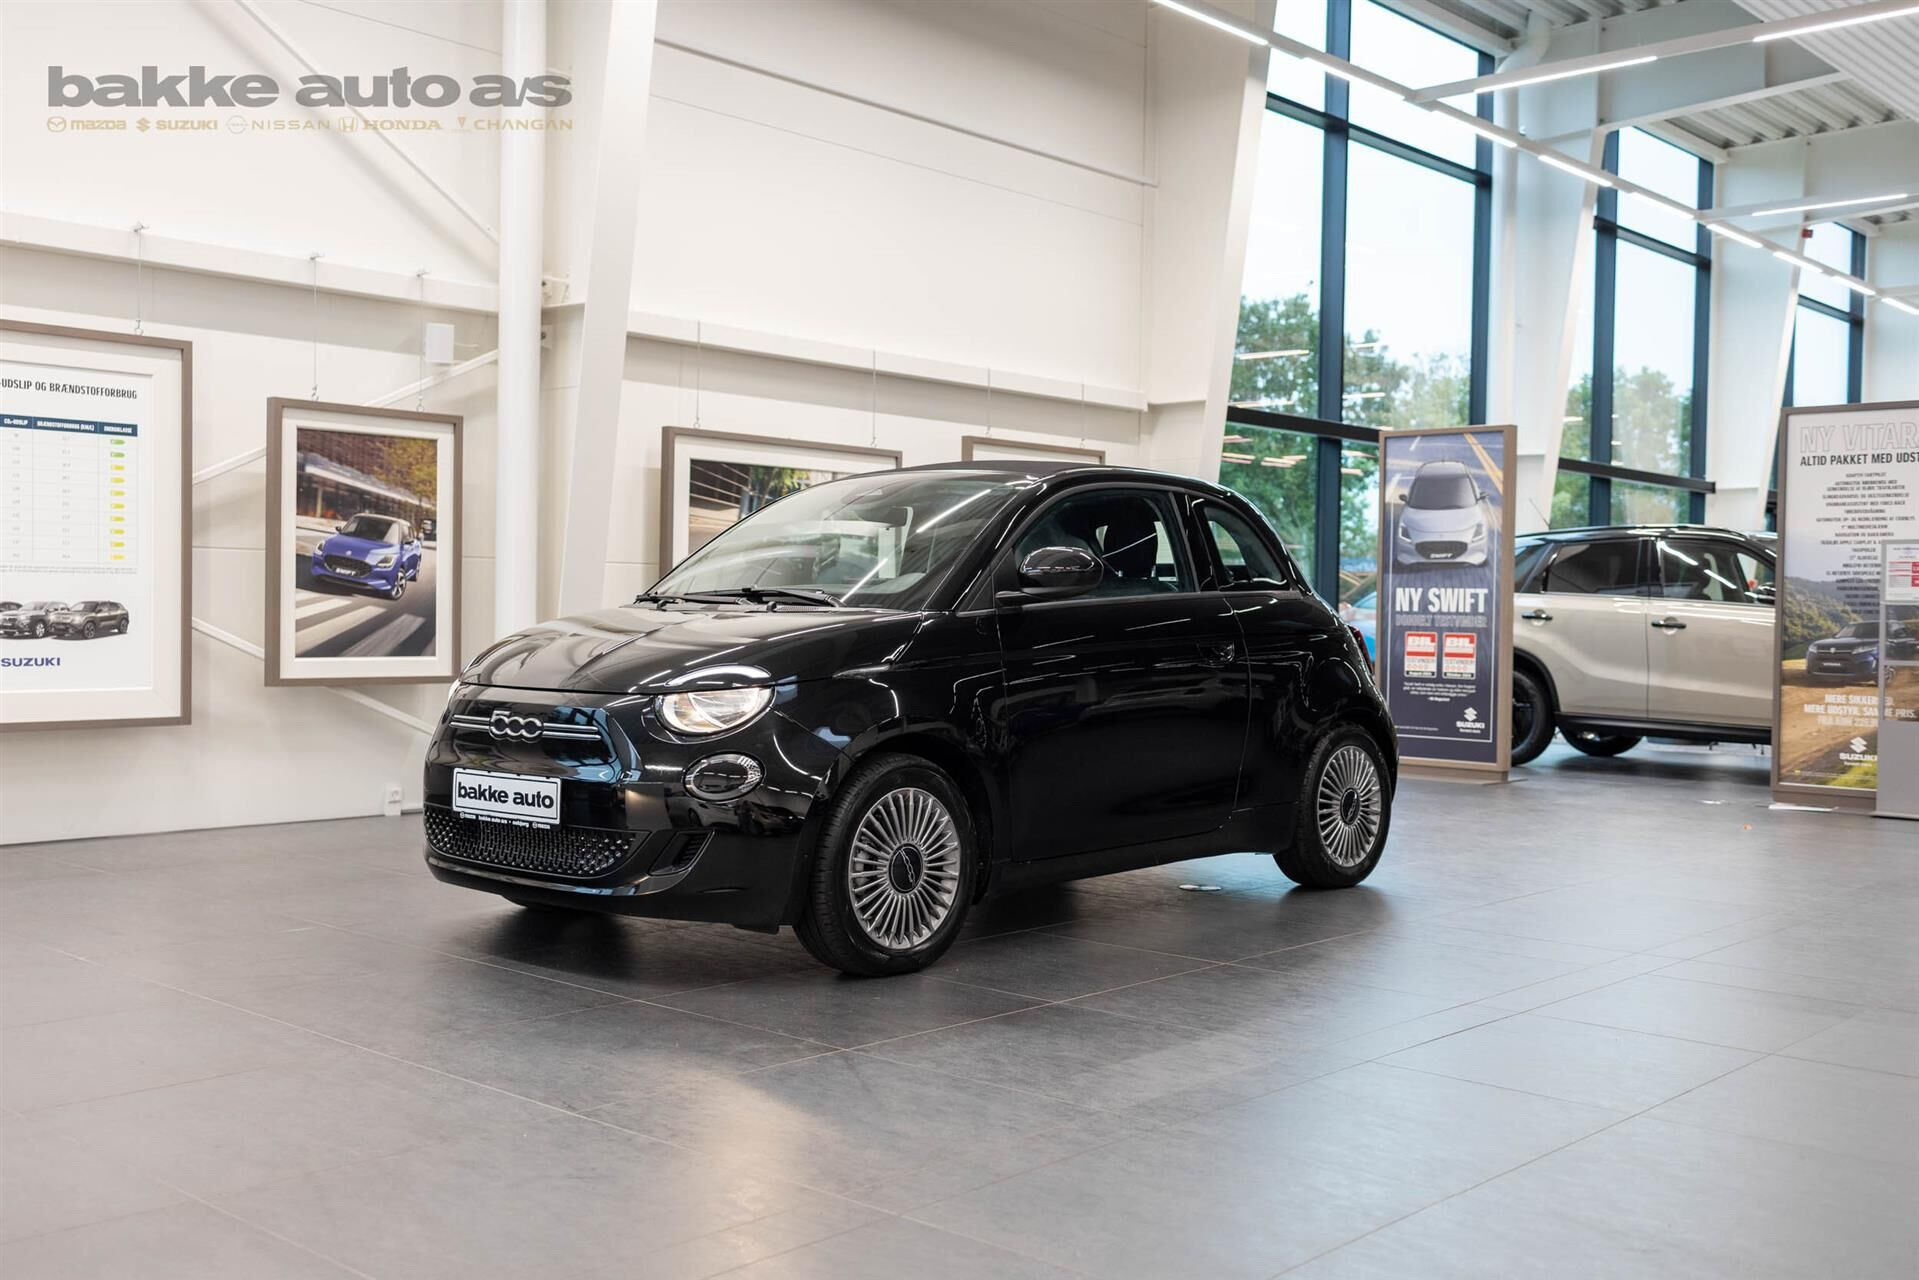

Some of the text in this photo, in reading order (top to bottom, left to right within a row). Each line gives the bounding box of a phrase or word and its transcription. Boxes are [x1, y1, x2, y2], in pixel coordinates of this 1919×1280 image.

[35, 381, 47, 391] OG
[49, 382, 137, 399] BRÆNDSTOFFORBRUG
[1800, 421, 1919, 454] NY VITAR
[1800, 456, 1827, 467] ALTID
[1830, 454, 1868, 465] PAKKET
[1871, 453, 1893, 464] MED
[1395, 587, 1489, 613] NY SWIFT
[1, 657, 61, 667] SUZUKI
[1824, 694, 1847, 704] MERE
[1804, 704, 1825, 714] MERE
[490, 710, 542, 737] 500
[1456, 721, 1485, 730] SUZUKI
[458, 781, 554, 809] bakke auto
